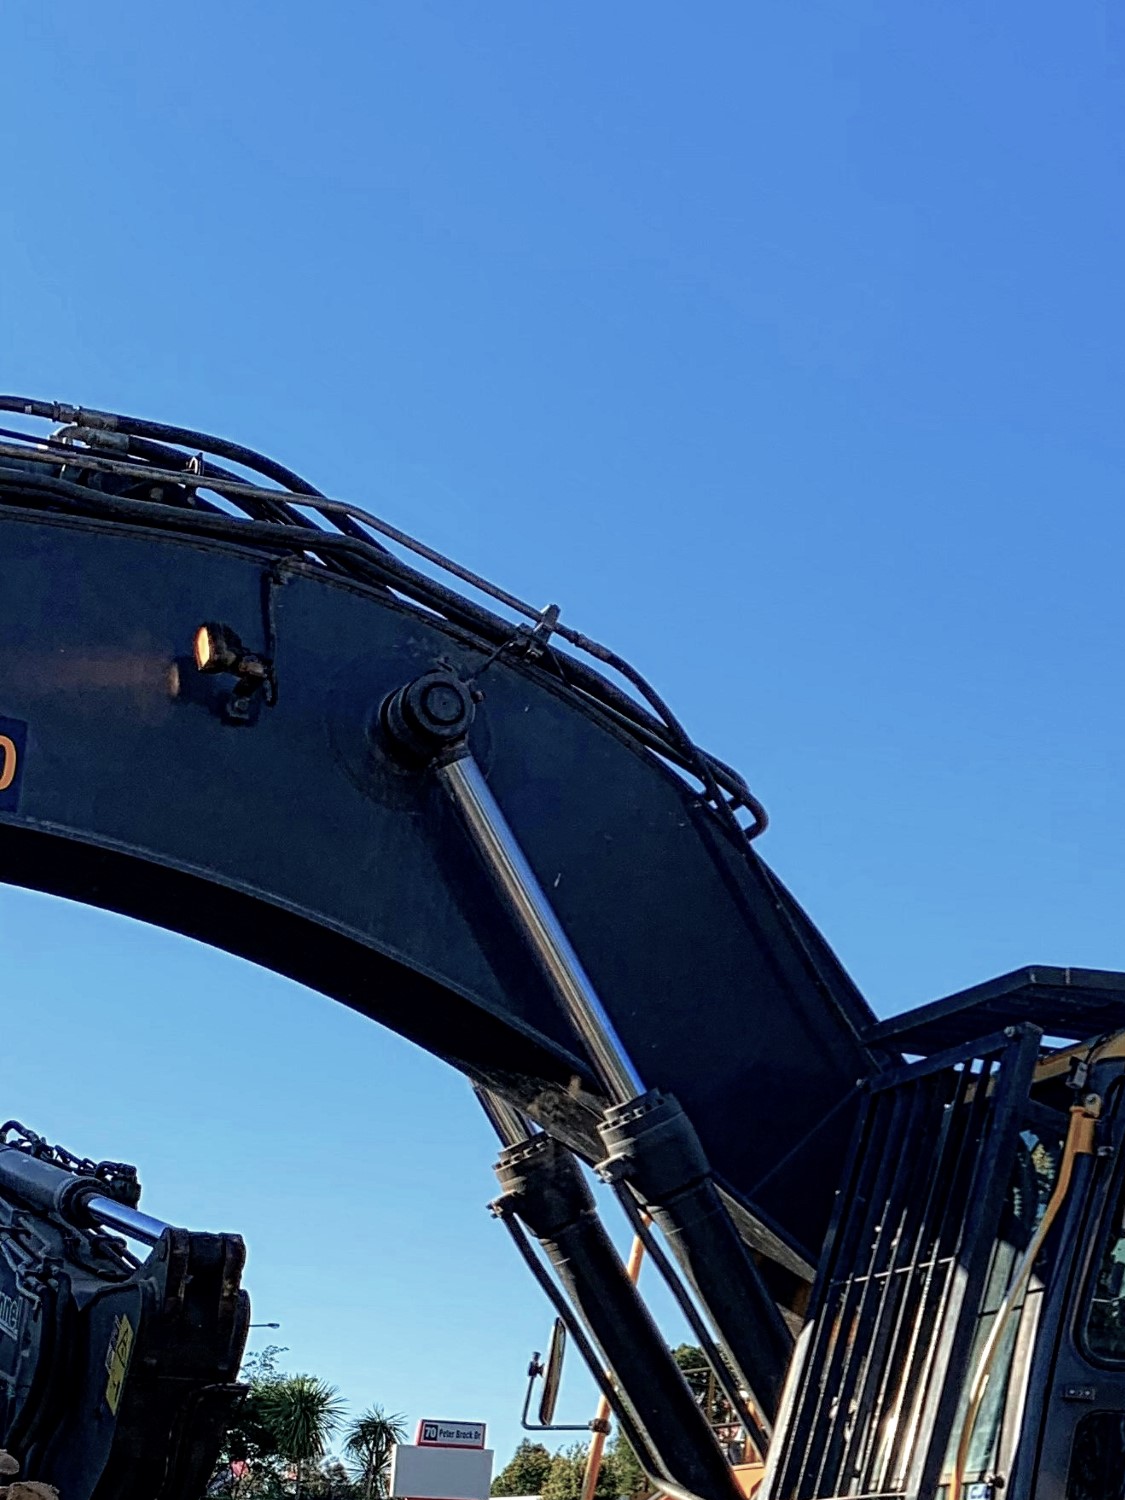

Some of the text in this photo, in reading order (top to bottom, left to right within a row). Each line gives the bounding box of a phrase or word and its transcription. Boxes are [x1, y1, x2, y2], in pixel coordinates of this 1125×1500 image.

[425, 1426, 481, 1440] 70 Peter Brock Dr
